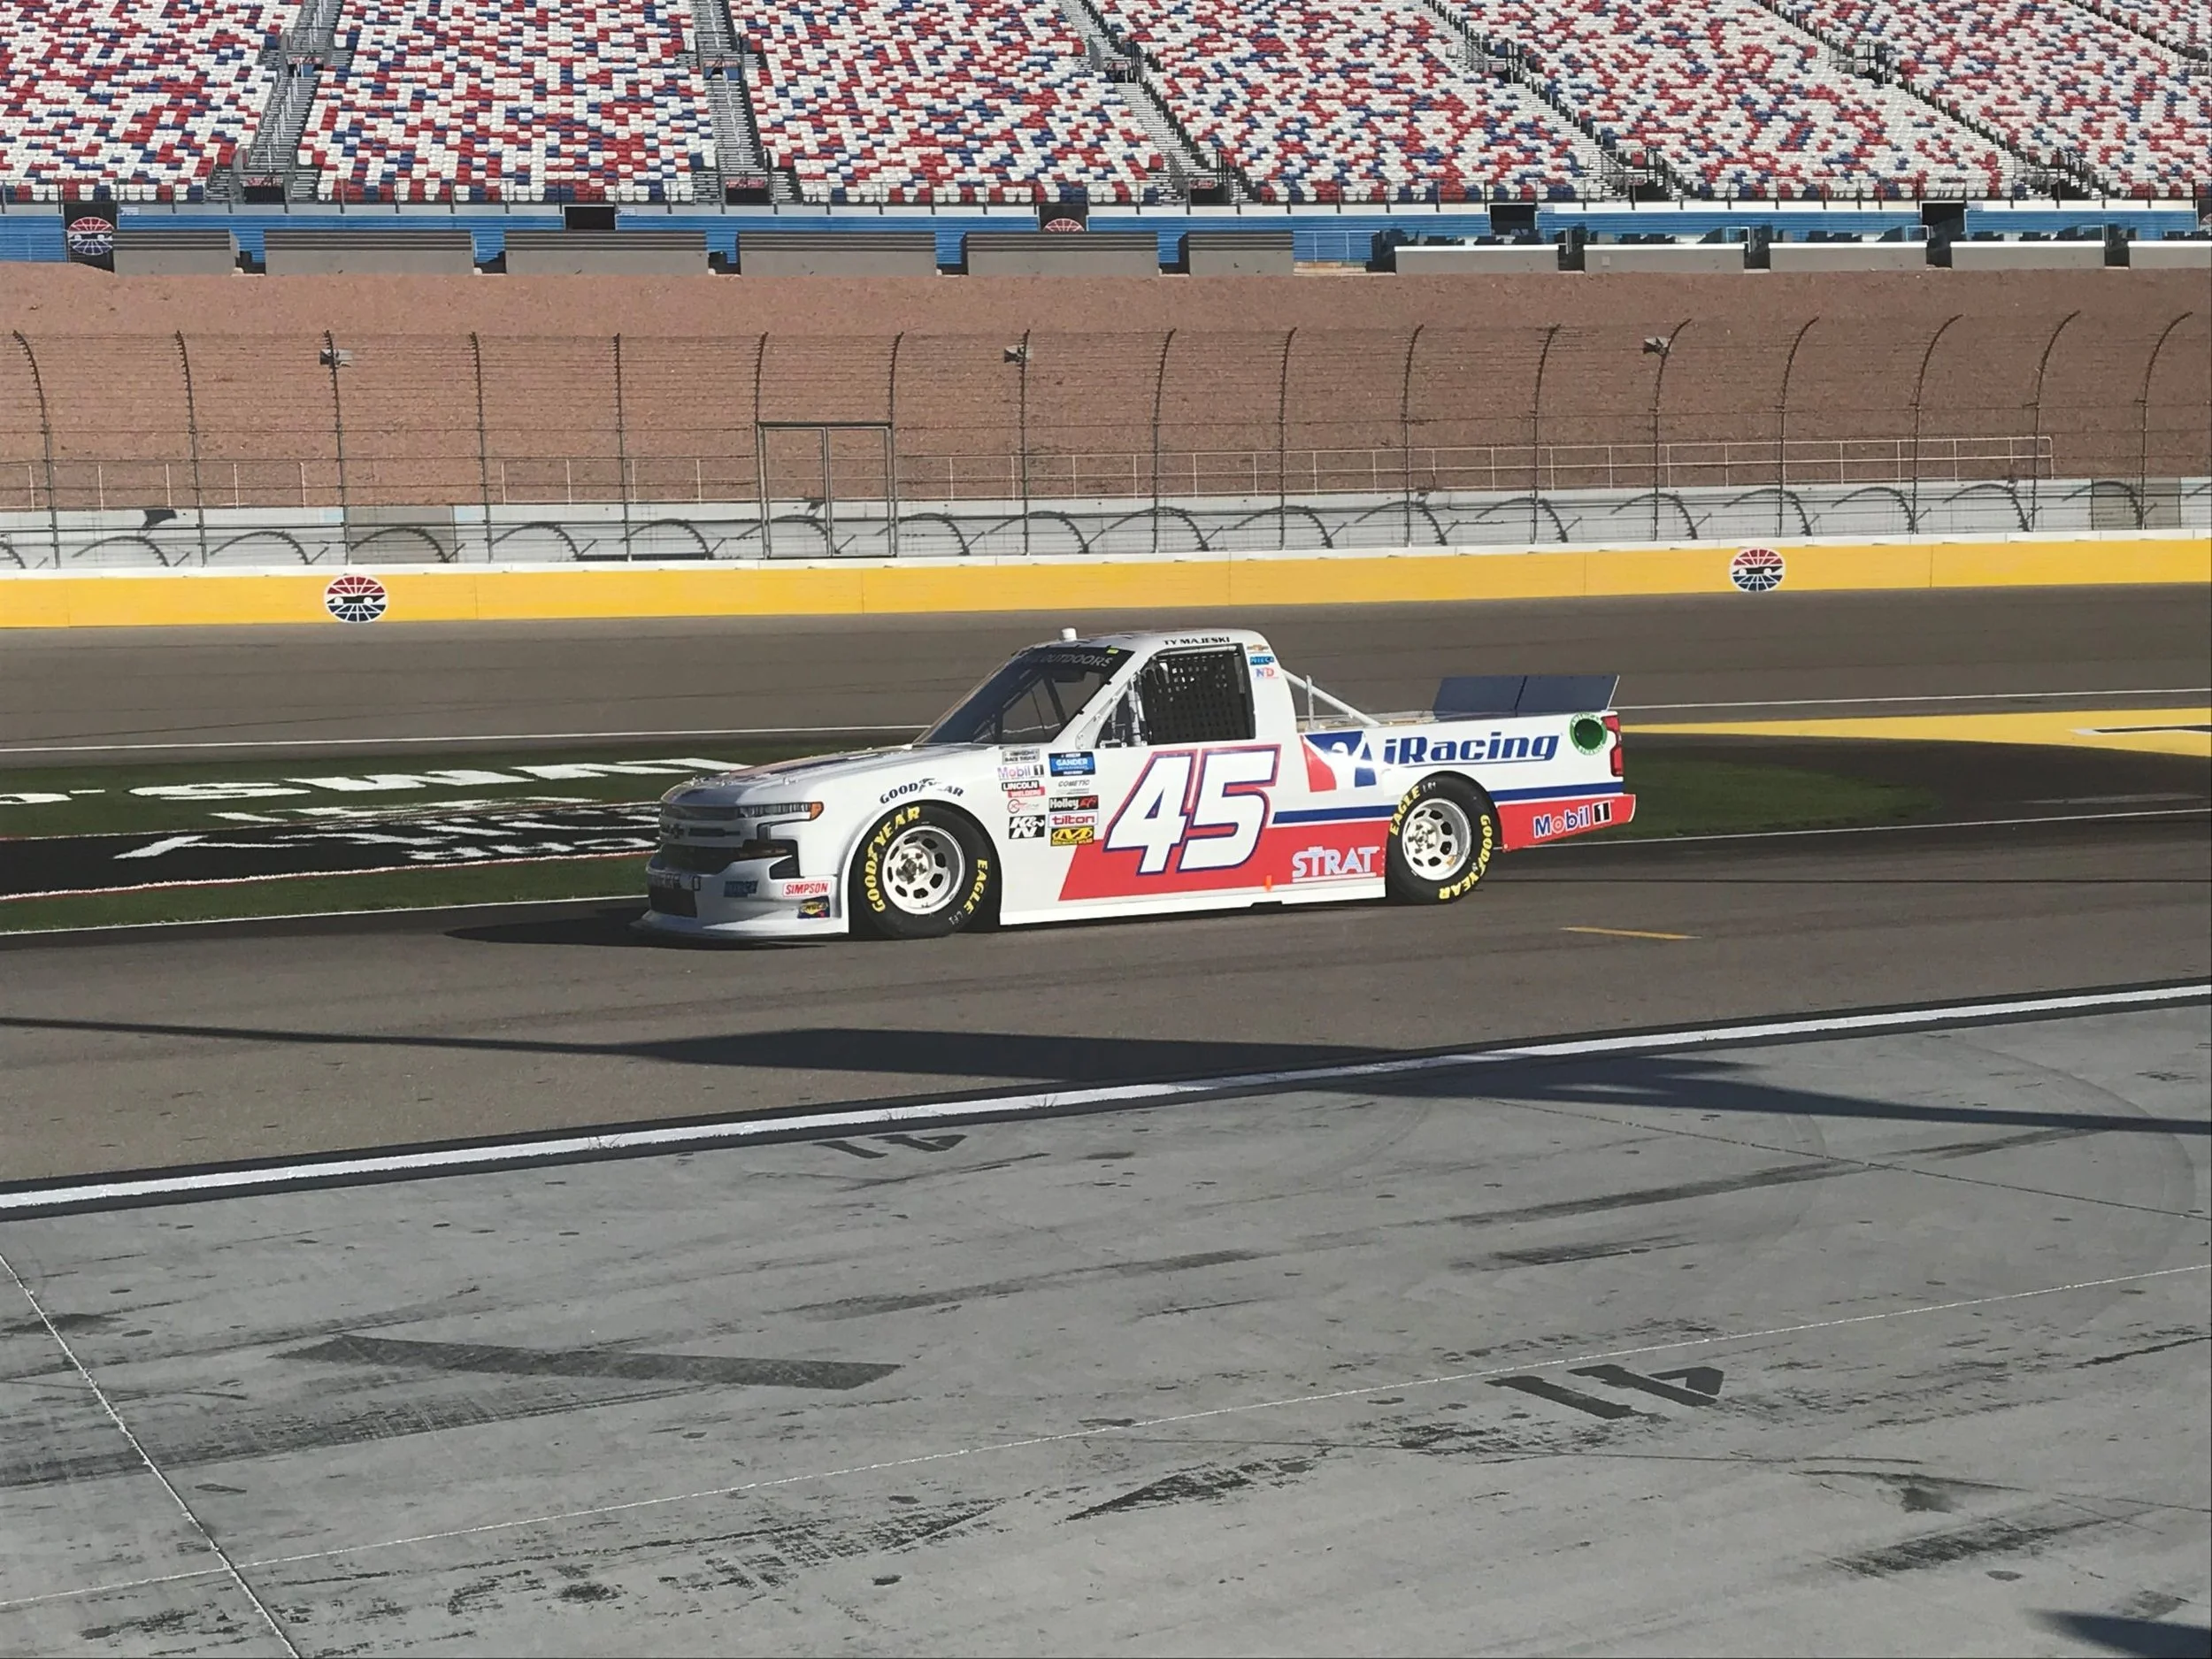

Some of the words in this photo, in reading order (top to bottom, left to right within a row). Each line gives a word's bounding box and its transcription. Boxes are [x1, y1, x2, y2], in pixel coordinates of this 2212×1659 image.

[1383, 732, 1559, 765] iRacing
[997, 764, 1032, 780] Mobil
[1033, 764, 1044, 776] 1
[1002, 781, 1039, 790] LINCOLN
[1049, 798, 1079, 810] Holley
[1052, 815, 1094, 826] tilton
[1102, 744, 1281, 876] 45
[1389, 786, 1421, 835] EAGLE
[1533, 805, 1590, 838] Mobil
[1592, 800, 1612, 825] 1
[864, 806, 920, 913] GOODYEAR
[1292, 846, 1380, 879] STRAT
[1439, 814, 1493, 900] GOODYEAR
[785, 883, 828, 895] SIMPSON
[964, 859, 988, 914] EAGLE
